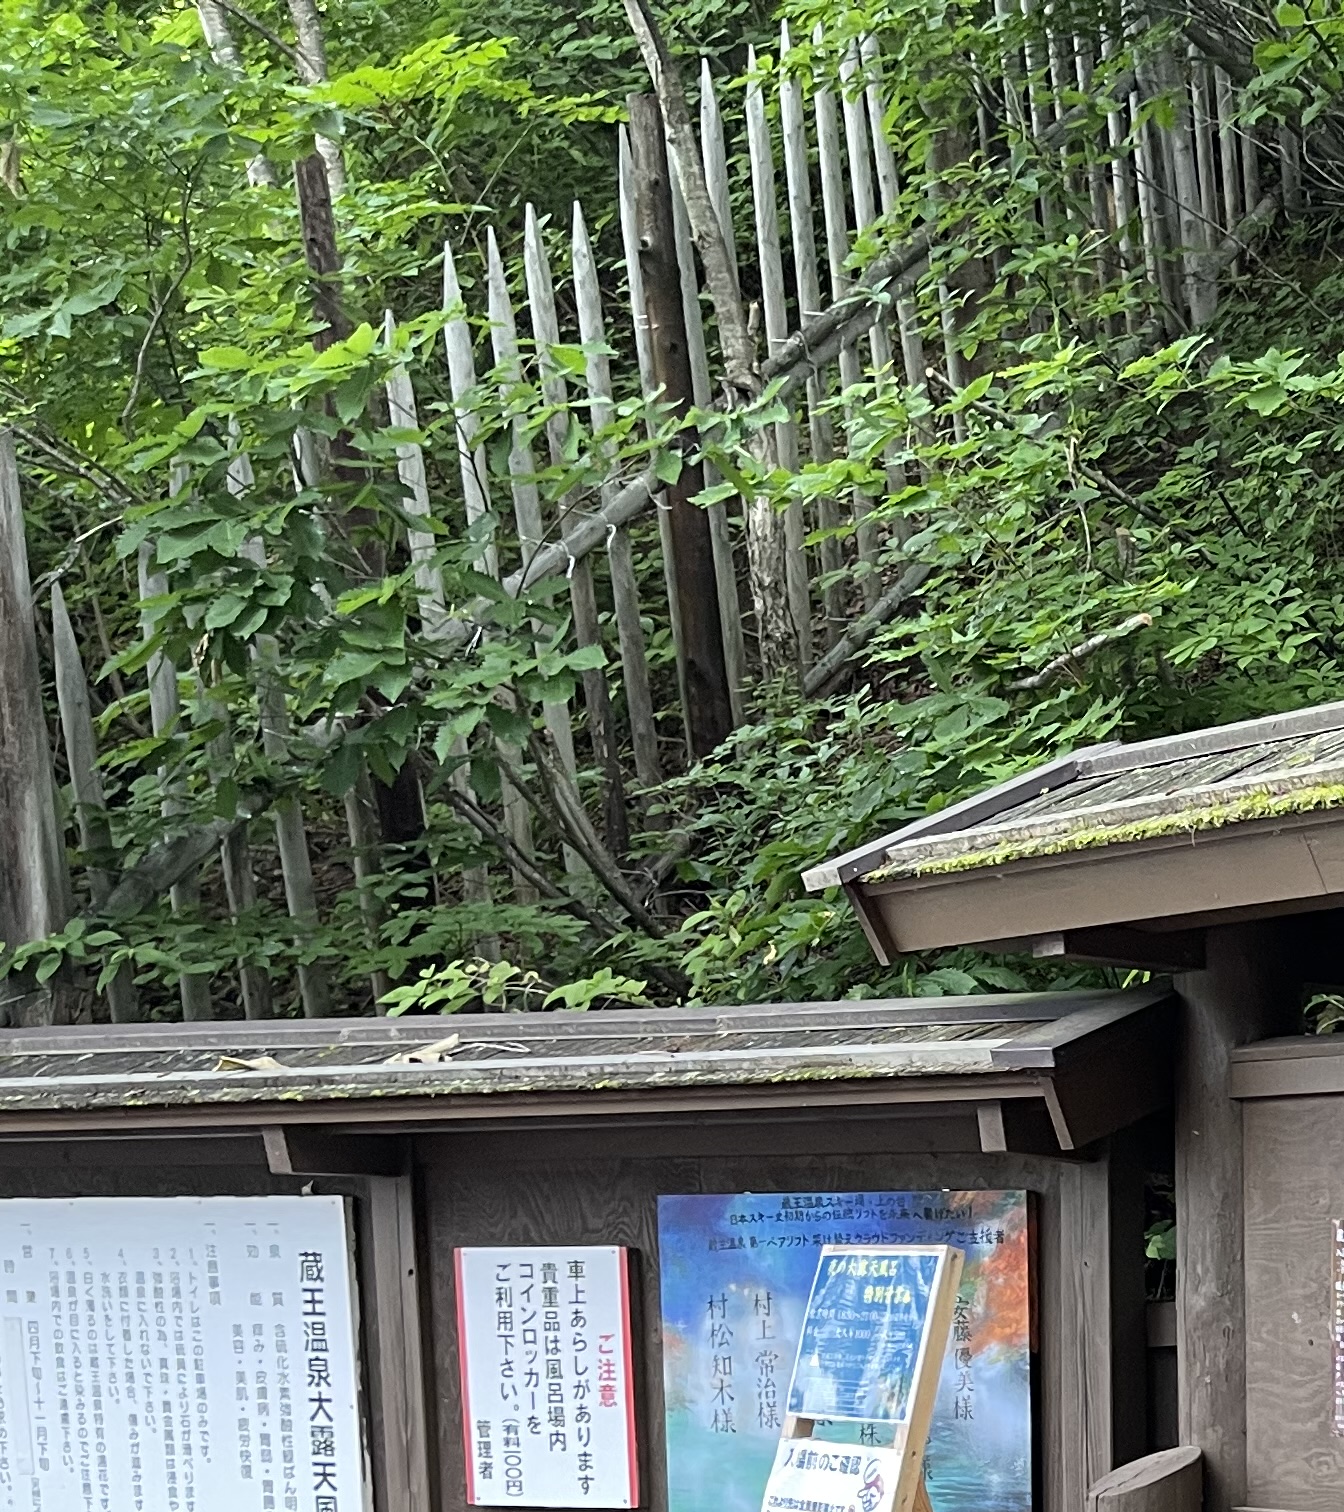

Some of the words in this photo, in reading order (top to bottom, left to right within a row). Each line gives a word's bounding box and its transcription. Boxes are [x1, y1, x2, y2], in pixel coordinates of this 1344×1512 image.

[519, 1262, 542, 1436] コインロッカーを
[540, 1262, 567, 1452] 貴重品は風呂場内
[566, 1259, 595, 1495] 車上あらしがあります
[598, 1333, 618, 1408] ご注意
[476, 1420, 494, 1480] 管理者
